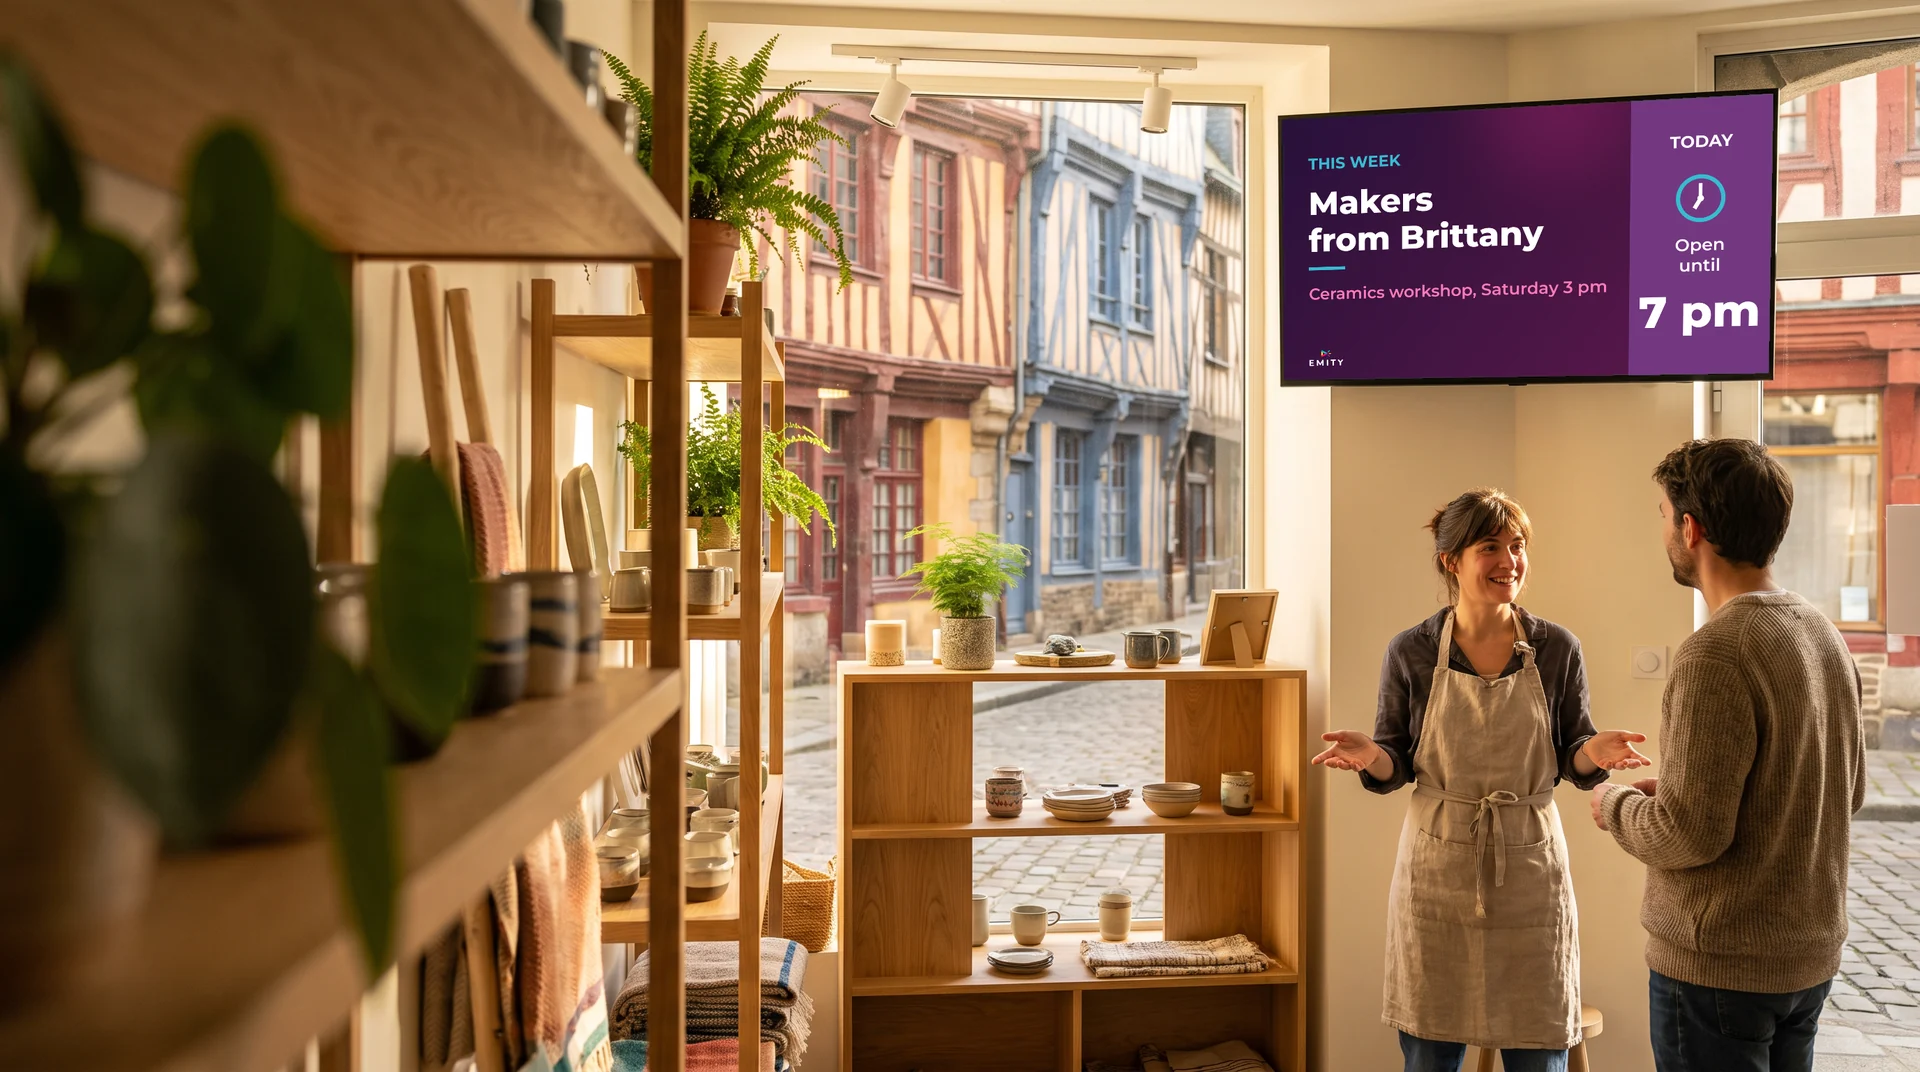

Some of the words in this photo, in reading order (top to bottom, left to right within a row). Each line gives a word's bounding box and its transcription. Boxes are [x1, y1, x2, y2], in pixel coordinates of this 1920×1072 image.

[1669, 133, 1734, 150] TODAY
[1307, 156, 1346, 171] THIS
[1349, 153, 1401, 169] WEEK
[1309, 188, 1434, 216] Makers
[1308, 226, 1390, 253] from
[1401, 220, 1545, 253] Brittany
[1675, 238, 1725, 255] Open
[1679, 257, 1720, 273] until
[1308, 285, 1385, 301] Ceramics
[1388, 283, 1477, 300] workshop,
[1481, 280, 1559, 298] Saturday
[1562, 280, 1573, 294] 3
[1578, 282, 1607, 297] pm
[1638, 296, 1667, 329] 7
[1682, 300, 1759, 337] pm
[1308, 358, 1344, 367] EMITY
